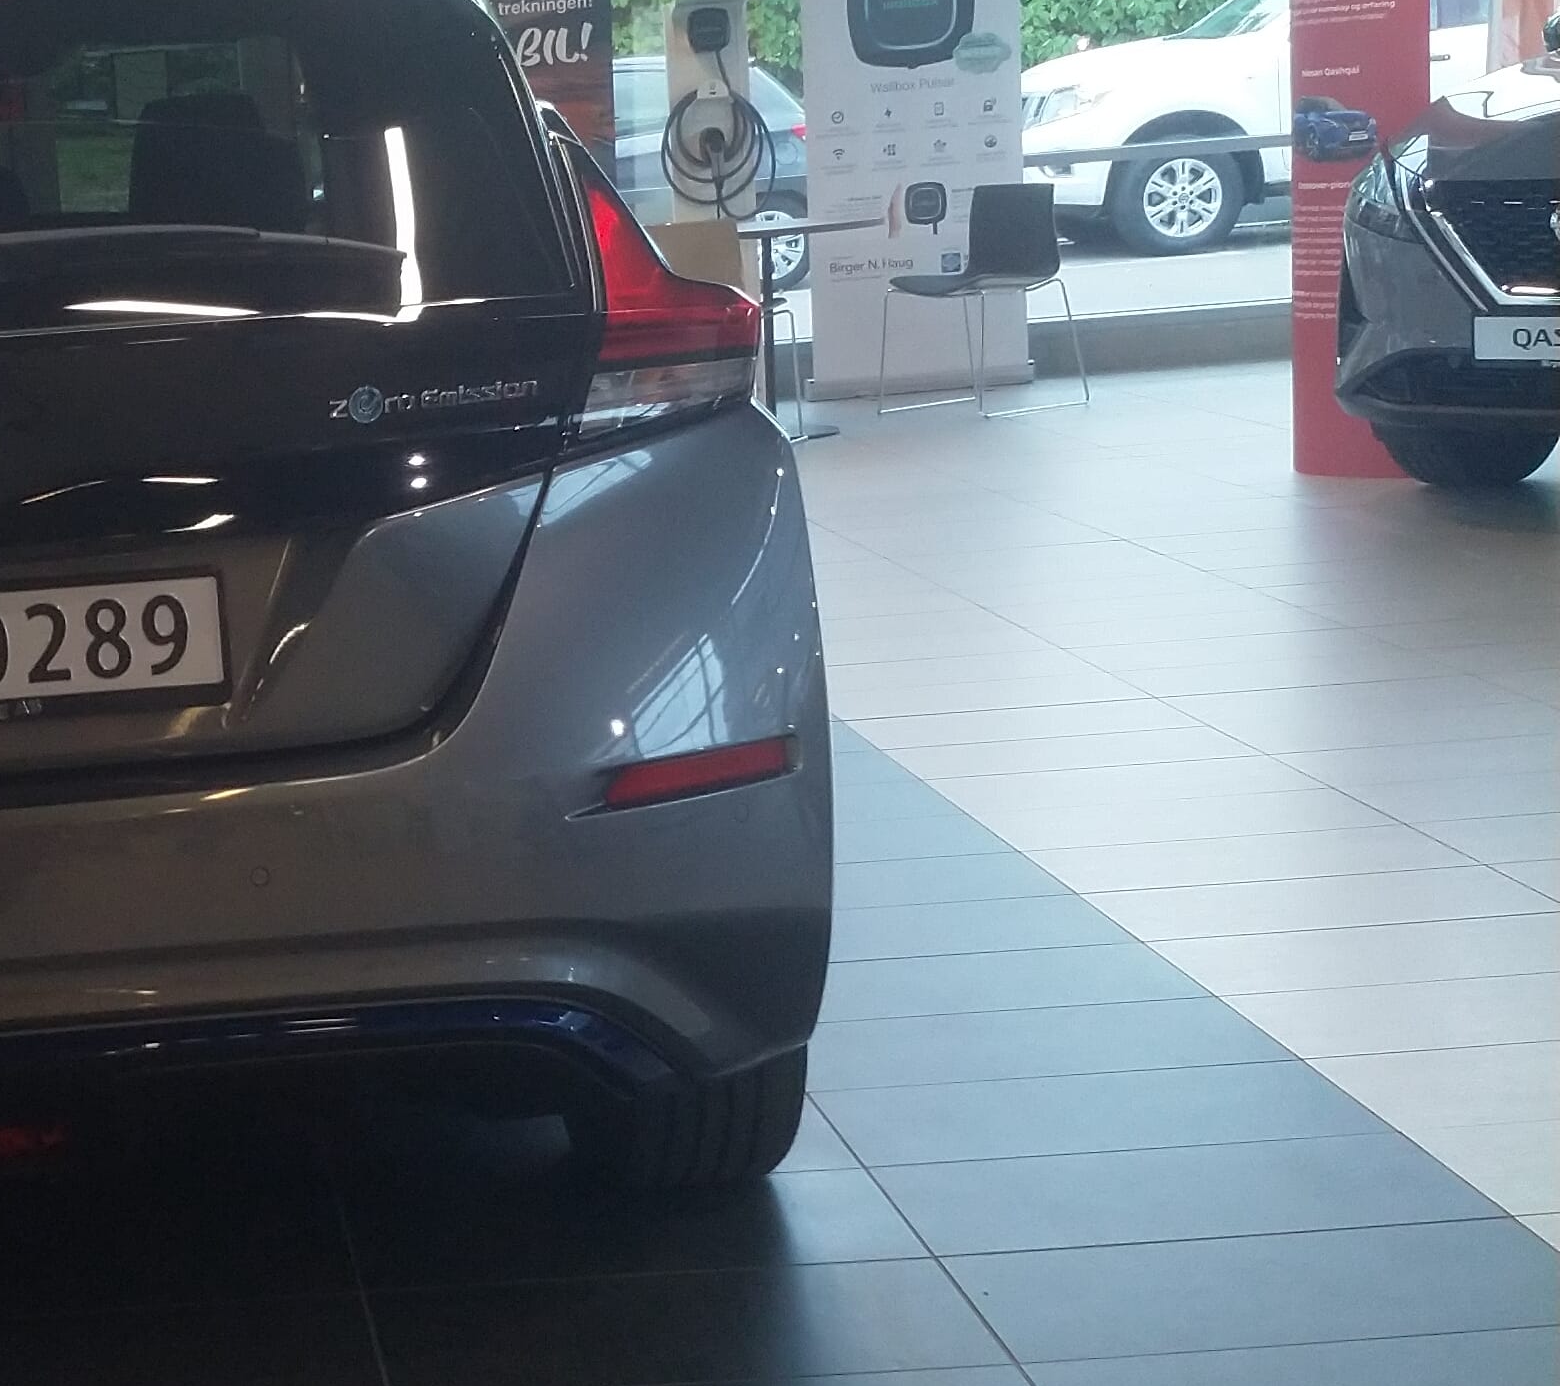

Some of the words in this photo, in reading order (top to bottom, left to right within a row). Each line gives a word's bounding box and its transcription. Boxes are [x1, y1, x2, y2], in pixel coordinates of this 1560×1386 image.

[516, 22, 593, 67] BIL!
[870, 82, 915, 94] Wallbox
[829, 261, 864, 275] Birger
[868, 259, 880, 269] N.
[883, 258, 914, 270] Haug
